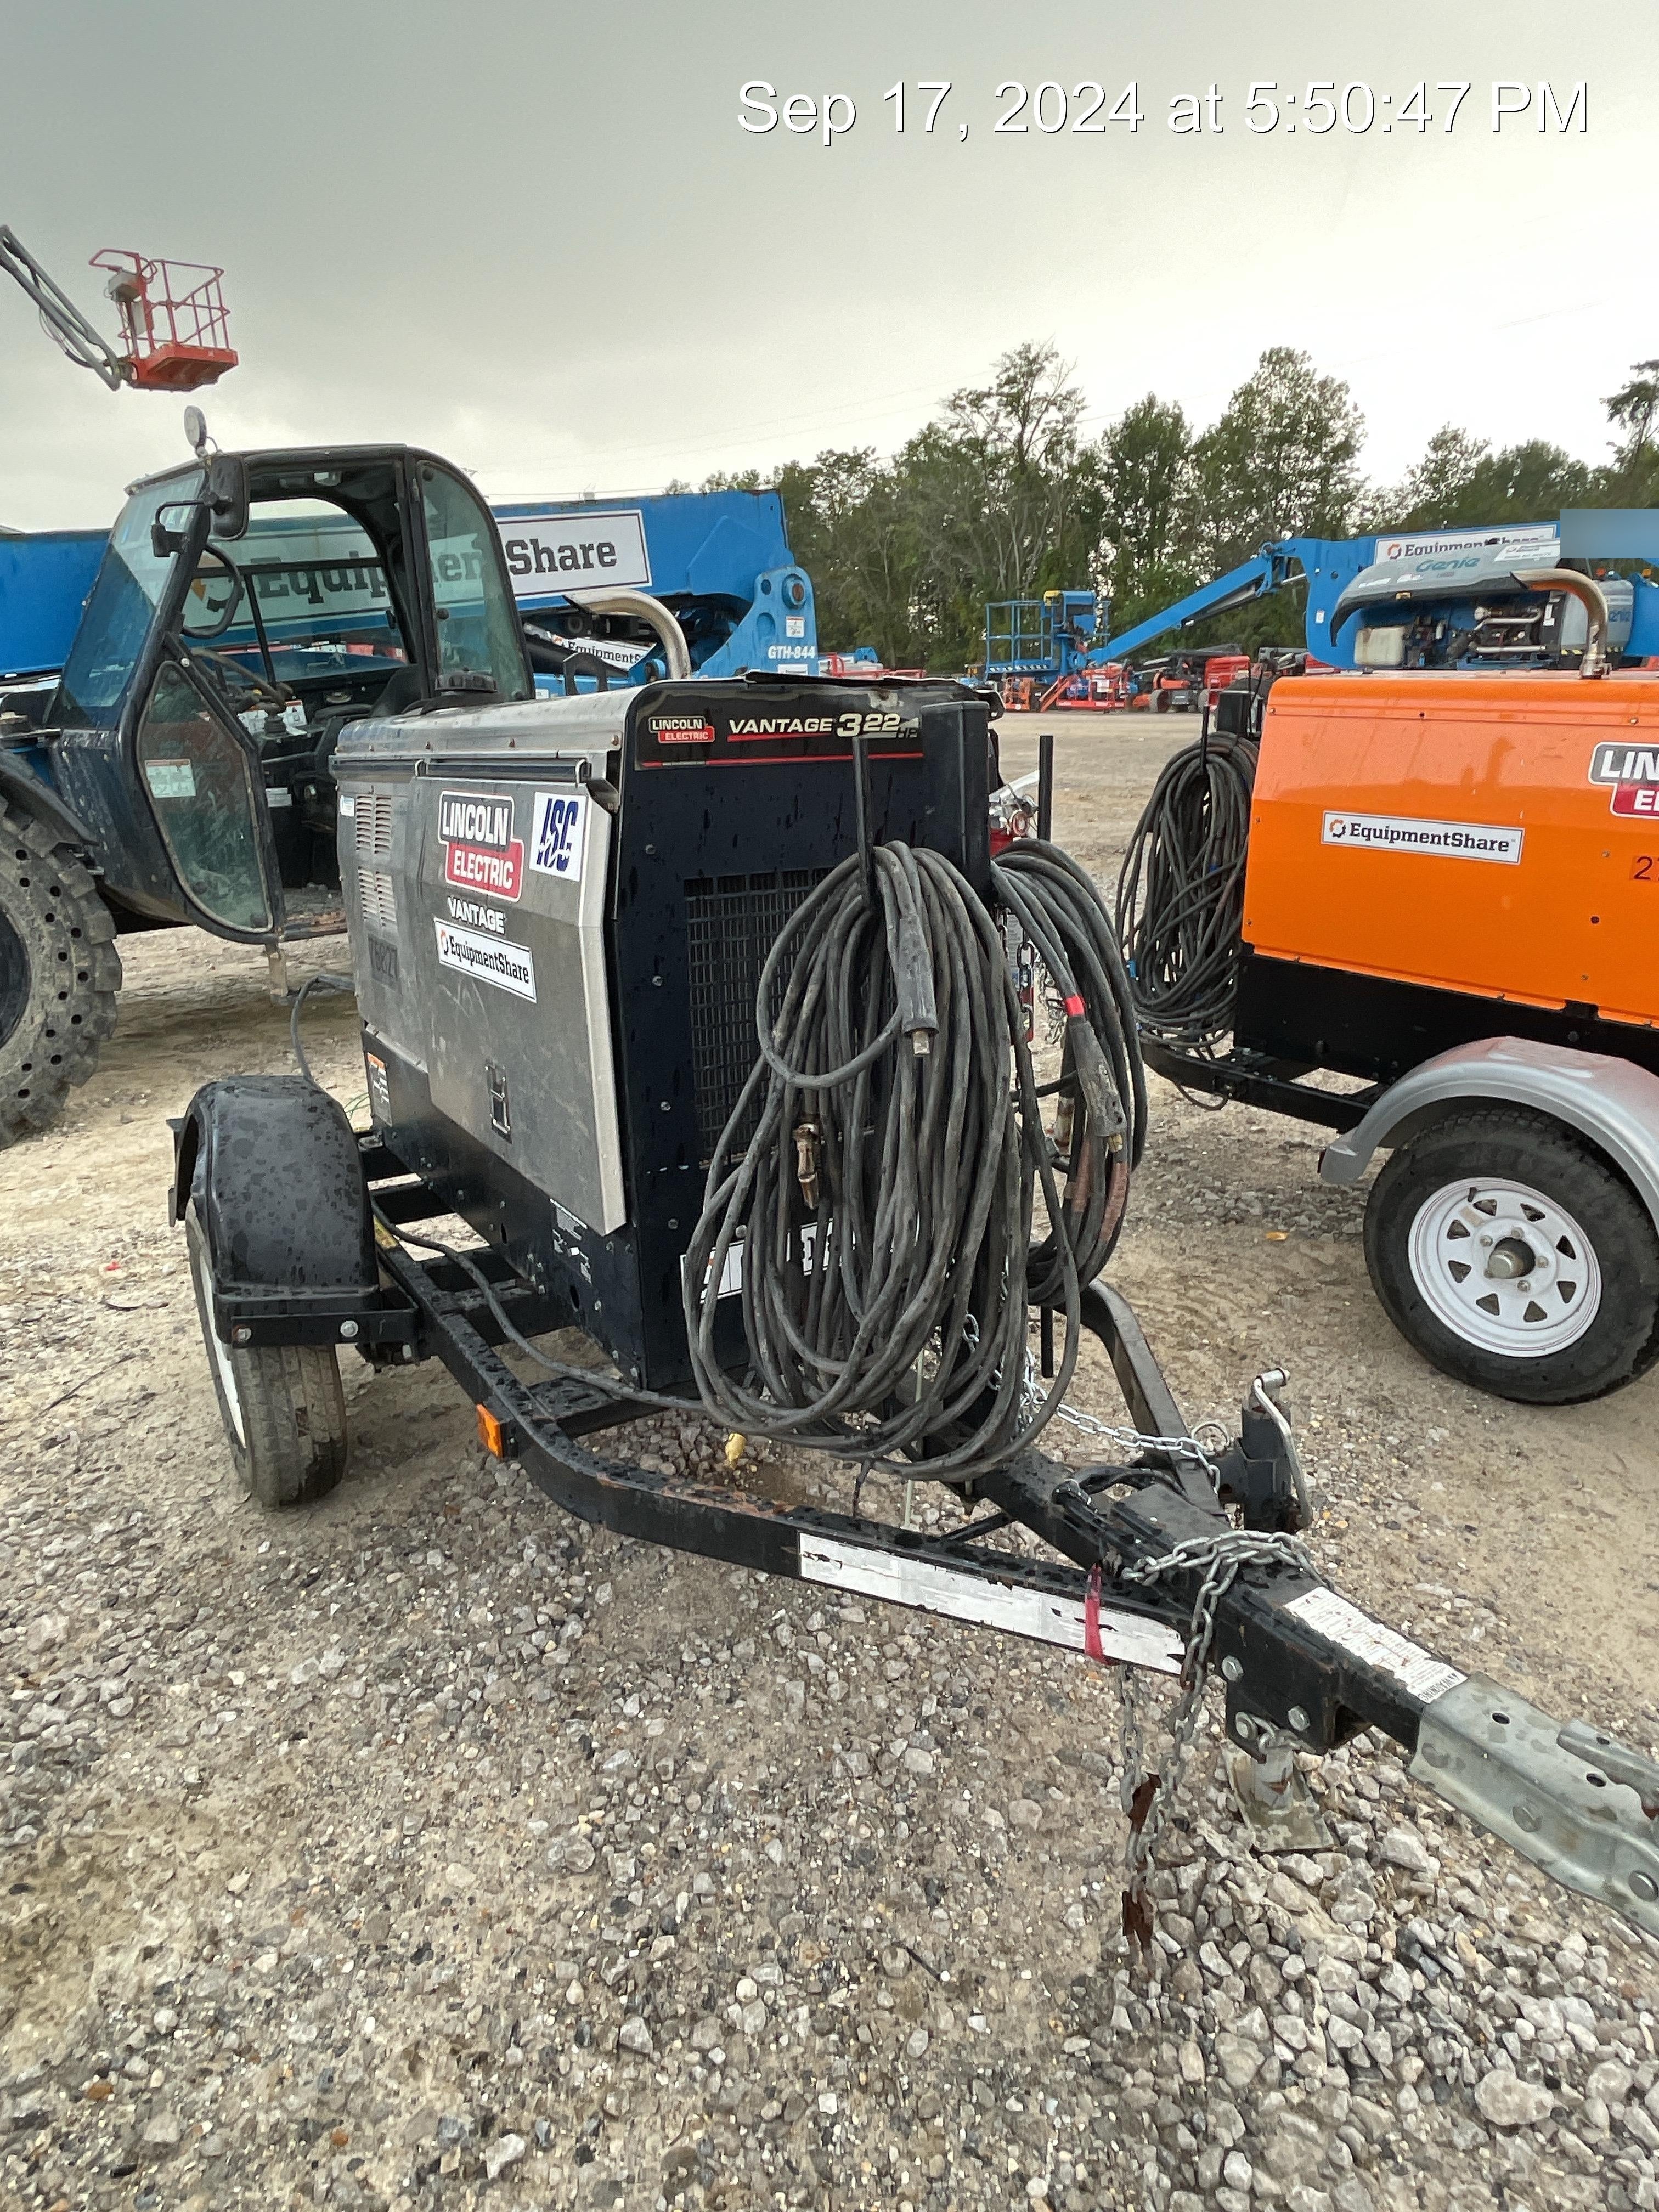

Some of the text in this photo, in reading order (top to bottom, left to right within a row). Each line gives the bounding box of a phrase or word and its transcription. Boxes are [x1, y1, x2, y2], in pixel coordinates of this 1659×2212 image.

[1415, 555, 1481, 572] Genie
[768, 645, 815, 659] GTH-844
[652, 719, 702, 730] LINCOLN
[665, 731, 709, 741] ELECTRIC
[729, 718, 833, 733] VANTAGE
[836, 713, 901, 737] 322
[1600, 751, 1659, 780] LIN
[442, 802, 509, 845] LINCOLN
[536, 798, 578, 871] ISC
[1350, 822, 1510, 852] EquipmentShare
[453, 849, 514, 889] ELECTRIC
[1634, 856, 1659, 880] 2
[447, 896, 505, 935] VANTAGE
[449, 935, 529, 984] EquipmentShare
